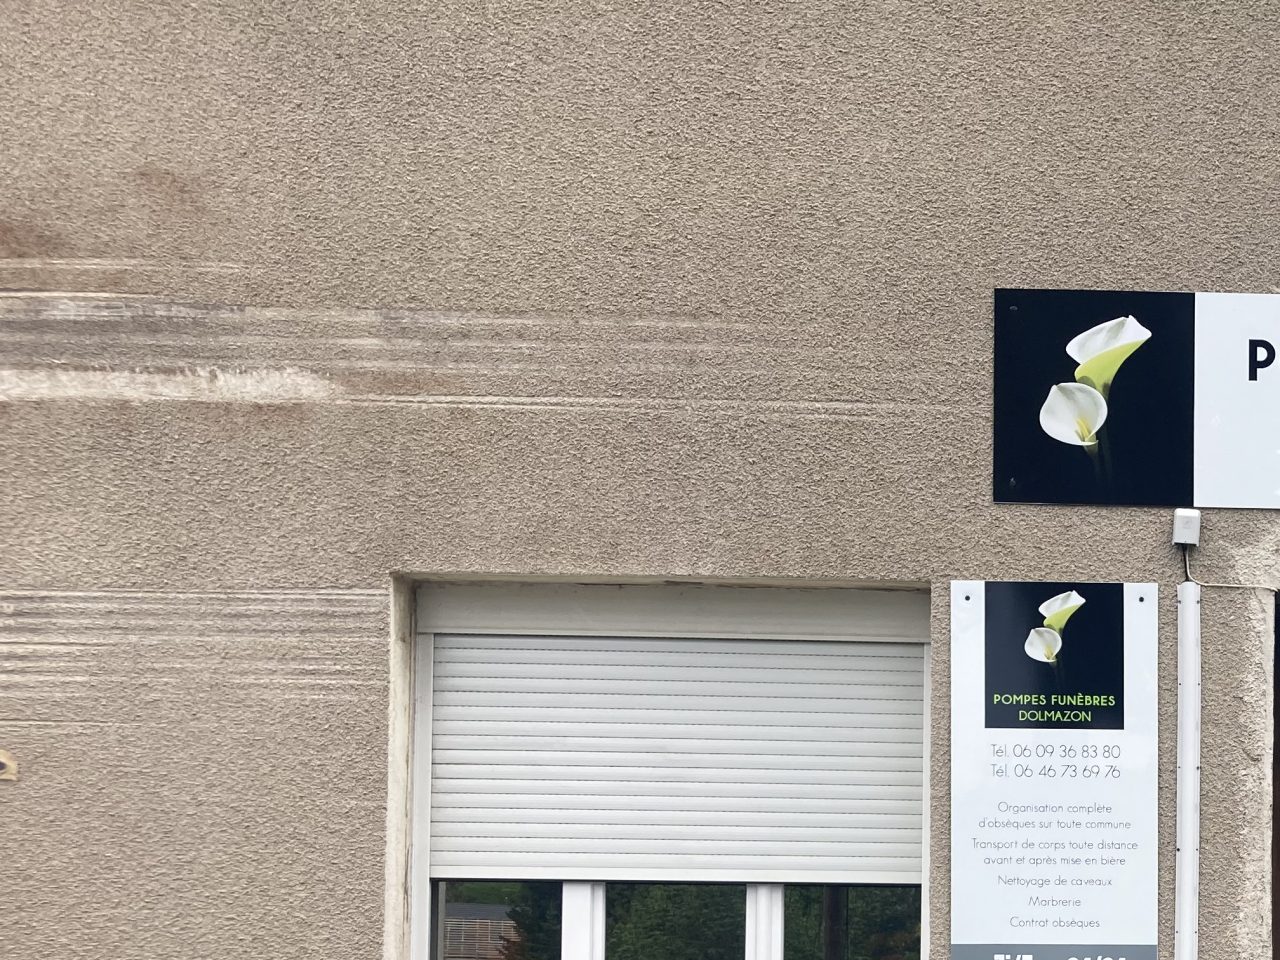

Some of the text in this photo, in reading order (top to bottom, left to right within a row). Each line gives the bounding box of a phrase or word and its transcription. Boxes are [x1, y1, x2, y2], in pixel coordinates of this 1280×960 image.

[993, 692, 1116, 706] POMPES FUNÈBRES
[1019, 710, 1092, 722] DOLMAZON
[991, 744, 1121, 759] Tél. 06 09 36 83 80
[991, 764, 1121, 778] Tél. 06 46 73 69 76
[998, 801, 1112, 815] Organisation complète
[978, 817, 1132, 830] d'obsèques sur toute commune
[972, 837, 1138, 851] Transport de corps toute distance
[983, 855, 1126, 867] avant et après mise en bière
[998, 875, 1112, 888] Nettoyage de caveaux
[1028, 896, 1081, 907] Marbrerie
[1009, 916, 1100, 929] Contrat obsèques
